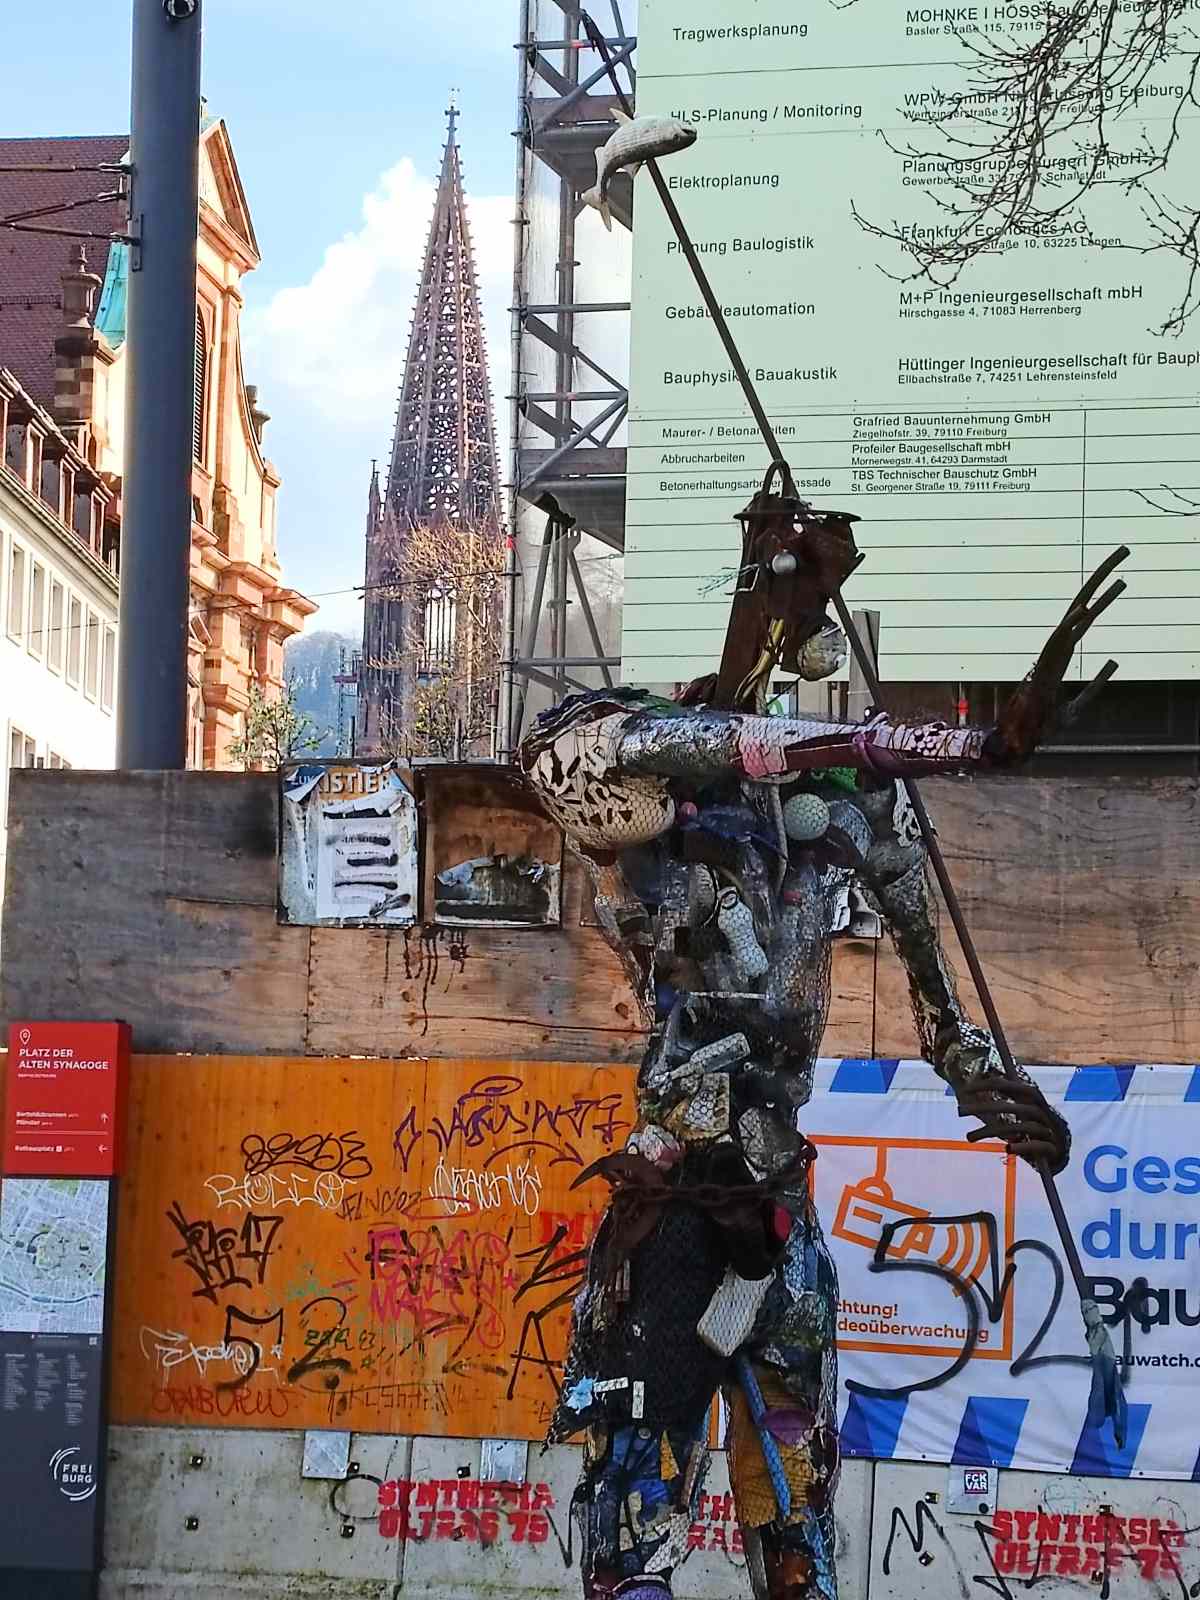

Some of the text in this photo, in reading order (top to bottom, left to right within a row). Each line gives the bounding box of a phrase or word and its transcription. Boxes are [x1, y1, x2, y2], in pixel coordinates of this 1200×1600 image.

[906, 7, 978, 22] MOHNKE
[994, 4, 1040, 19] HÖSS
[673, 23, 808, 42] Tragwerksplanung
[905, 25, 939, 36] Basler
[1009, 21, 1042, 32] 79115
[1120, 84, 1184, 98] Freiburg
[671, 104, 862, 123] HLS-Planung / Monitoring
[902, 158, 1027, 174] Planungsgruppe
[1041, 155, 1087, 171] urgert
[668, 173, 779, 189] Elektroplanung
[902, 174, 984, 186] Gewerbestraße
[1045, 169, 1107, 181] Schallstdt
[1064, 220, 1087, 234] AG
[667, 235, 815, 255] Plnung Baulogistik
[1043, 237, 1078, 248] 63225
[899, 285, 1143, 307] M+P Ingenieurgesellschaft mbH
[665, 301, 816, 319] Gebäueautomation
[899, 307, 965, 319] Hirschgasse
[982, 305, 1016, 317] 71083
[1019, 304, 1082, 316] Herrenberg
[898, 356, 966, 373] Hüttinger
[970, 352, 1128, 371] Ingenieurgesellschaft
[1132, 351, 1152, 366] für
[664, 370, 740, 386] Bauphysik
[755, 366, 837, 381] Bauakustik
[989, 372, 1023, 383] 74251
[1026, 370, 1117, 382] Lehrensteinsfeld
[853, 412, 1051, 427] Grafried Bauunternehmung GmbH
[662, 428, 706, 438] Maurer-
[717, 424, 795, 437] Betonariten
[966, 427, 1007, 438] Freiburg
[899, 442, 982, 455] Baugesellschaft
[985, 440, 1011, 451] mbH
[660, 453, 745, 465] Abbrucharbeiten
[961, 455, 1008, 464] Darmstadt
[852, 467, 1037, 480] TBS Technischer Bauschutz GmbH
[993, 481, 1031, 491] Freiburg
[19, 1048, 74, 1058] PLATZ DER
[18, 1060, 109, 1070] ALTEN SYNAGOGE
[1081, 1208, 1200, 1260] dur
[836, 1300, 898, 1318] chtung!
[837, 1317, 989, 1343] deoüberwachug
[1114, 1352, 1200, 1368] auwatch.c
[62, 1463, 93, 1474] FREI
[62, 1474, 93, 1483] BURG
[965, 1473, 987, 1482] FCK
